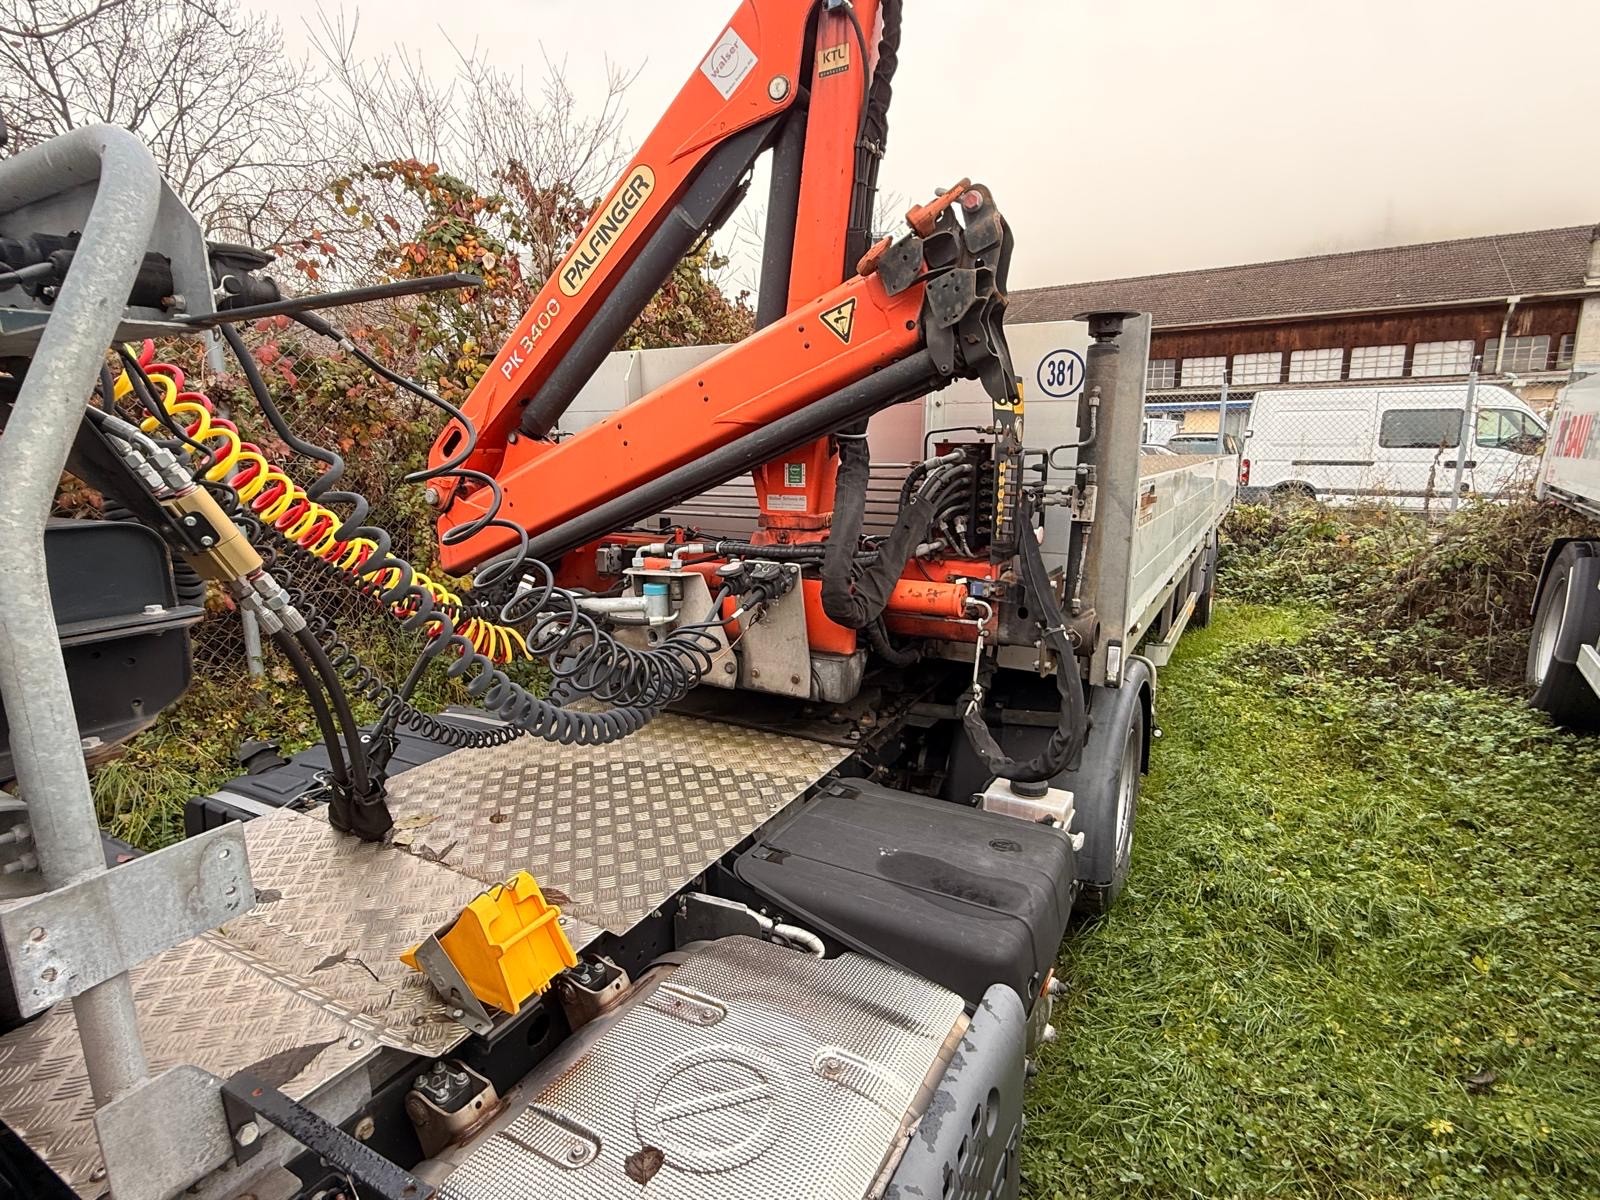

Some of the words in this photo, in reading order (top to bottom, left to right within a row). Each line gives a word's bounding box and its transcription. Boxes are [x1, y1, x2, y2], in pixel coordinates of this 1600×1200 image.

[711, 40, 739, 78] walser
[823, 49, 845, 64] KTL
[563, 174, 650, 290] PALFINGER
[501, 350, 524, 380] PK
[519, 298, 561, 354] 3400
[1047, 359, 1075, 387] 381
